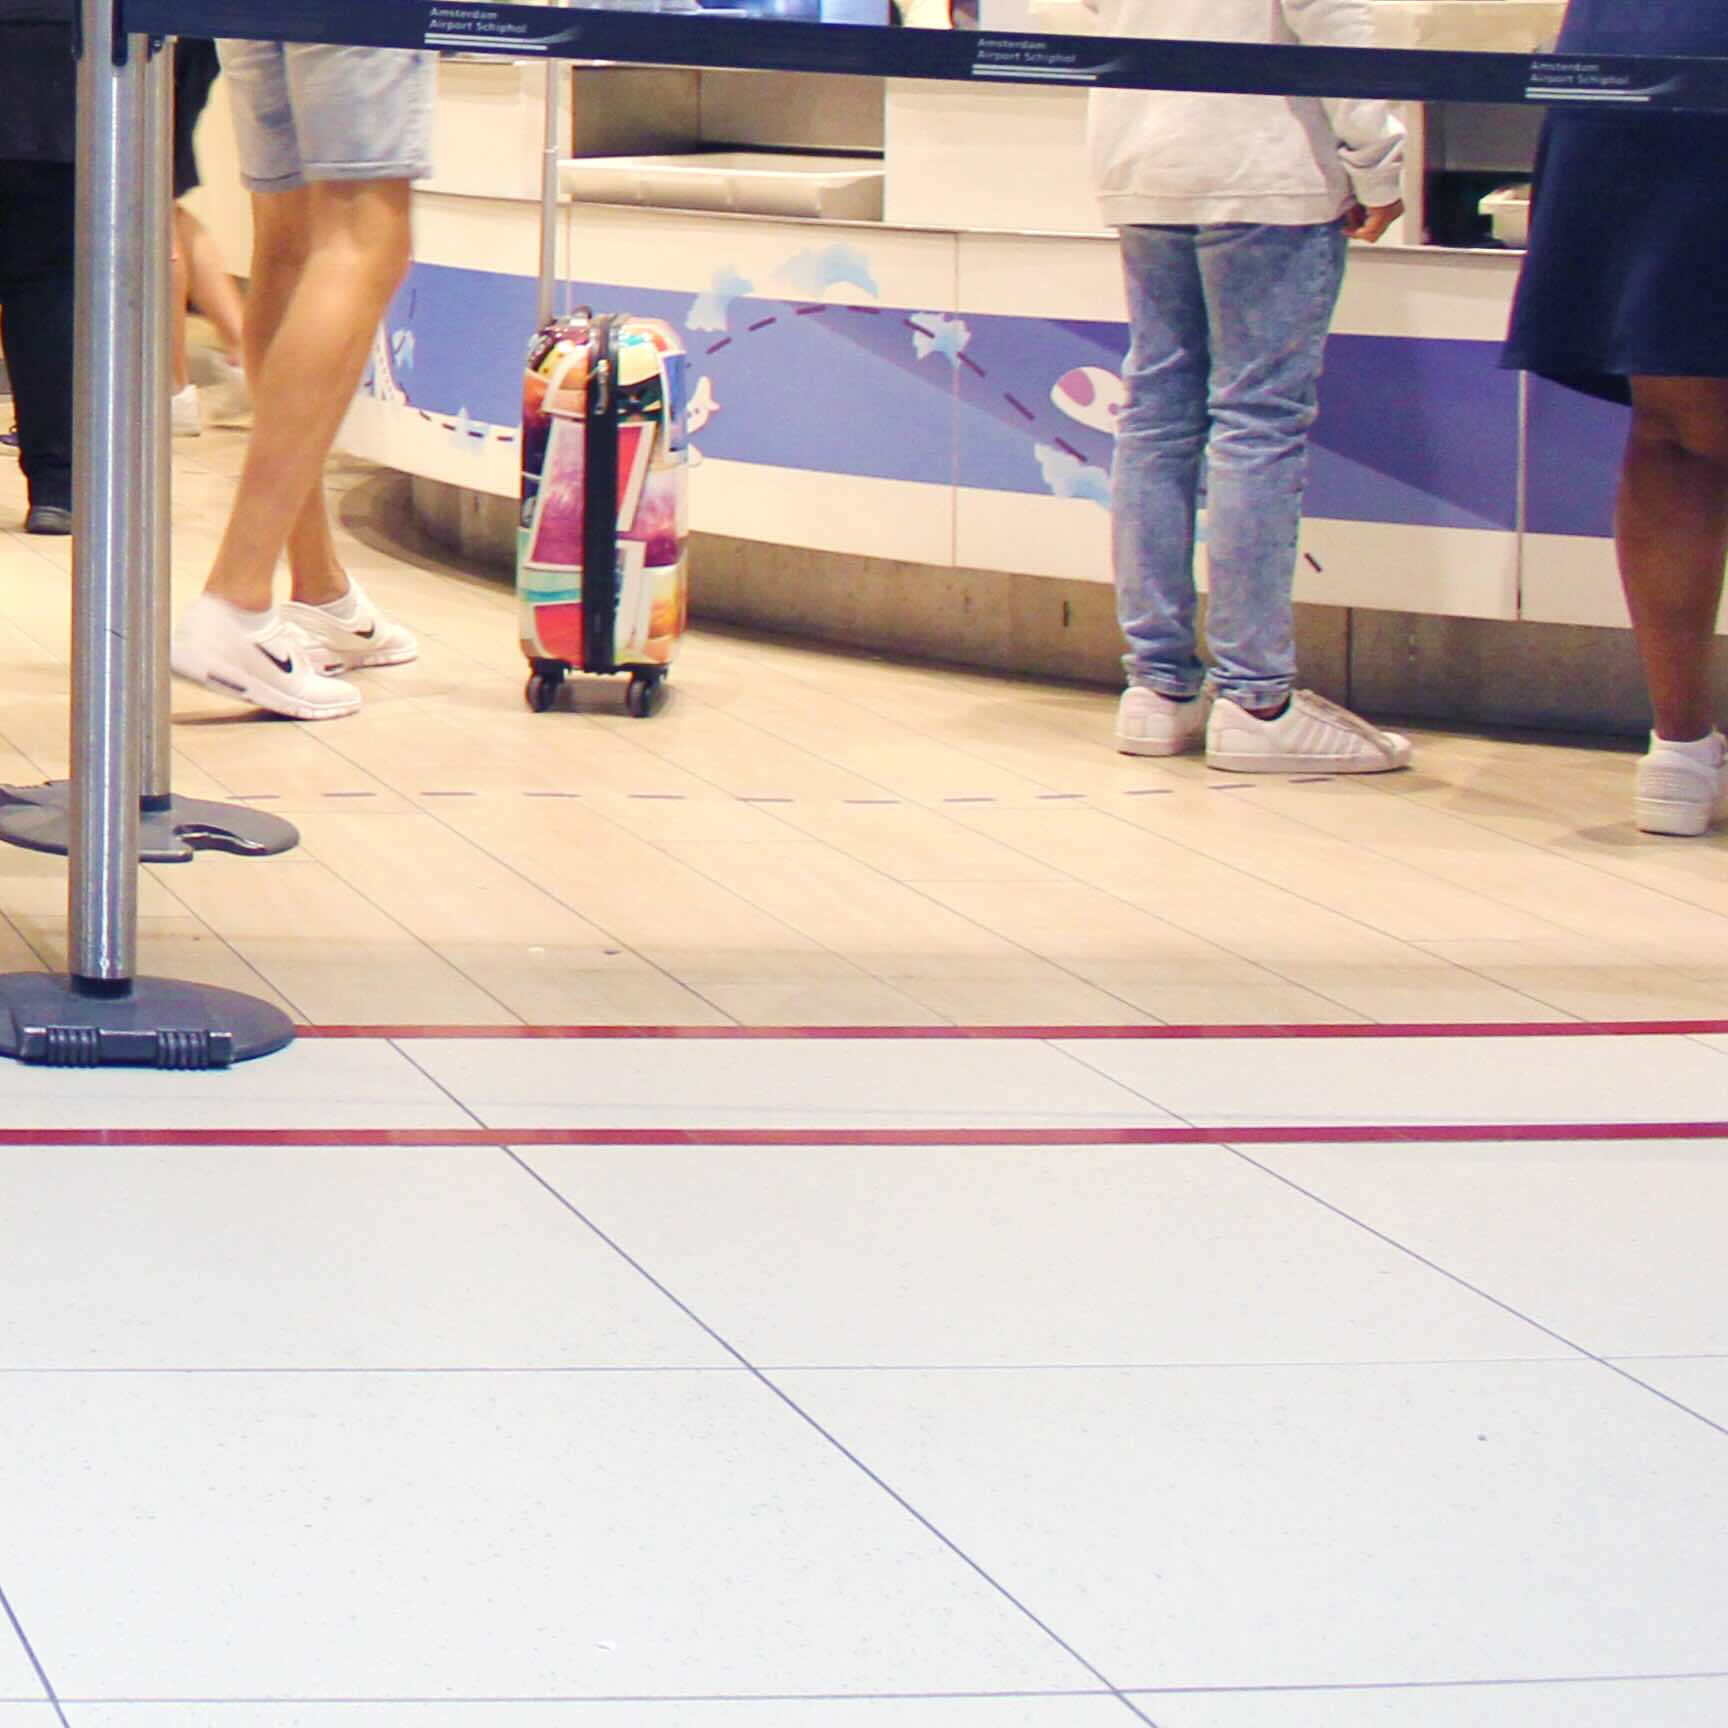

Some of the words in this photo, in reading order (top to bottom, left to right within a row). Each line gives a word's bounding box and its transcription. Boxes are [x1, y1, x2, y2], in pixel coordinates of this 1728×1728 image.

[429, 7, 498, 20] Amsterdam
[429, 19, 473, 31] Airport
[476, 21, 528, 34] Schiphol
